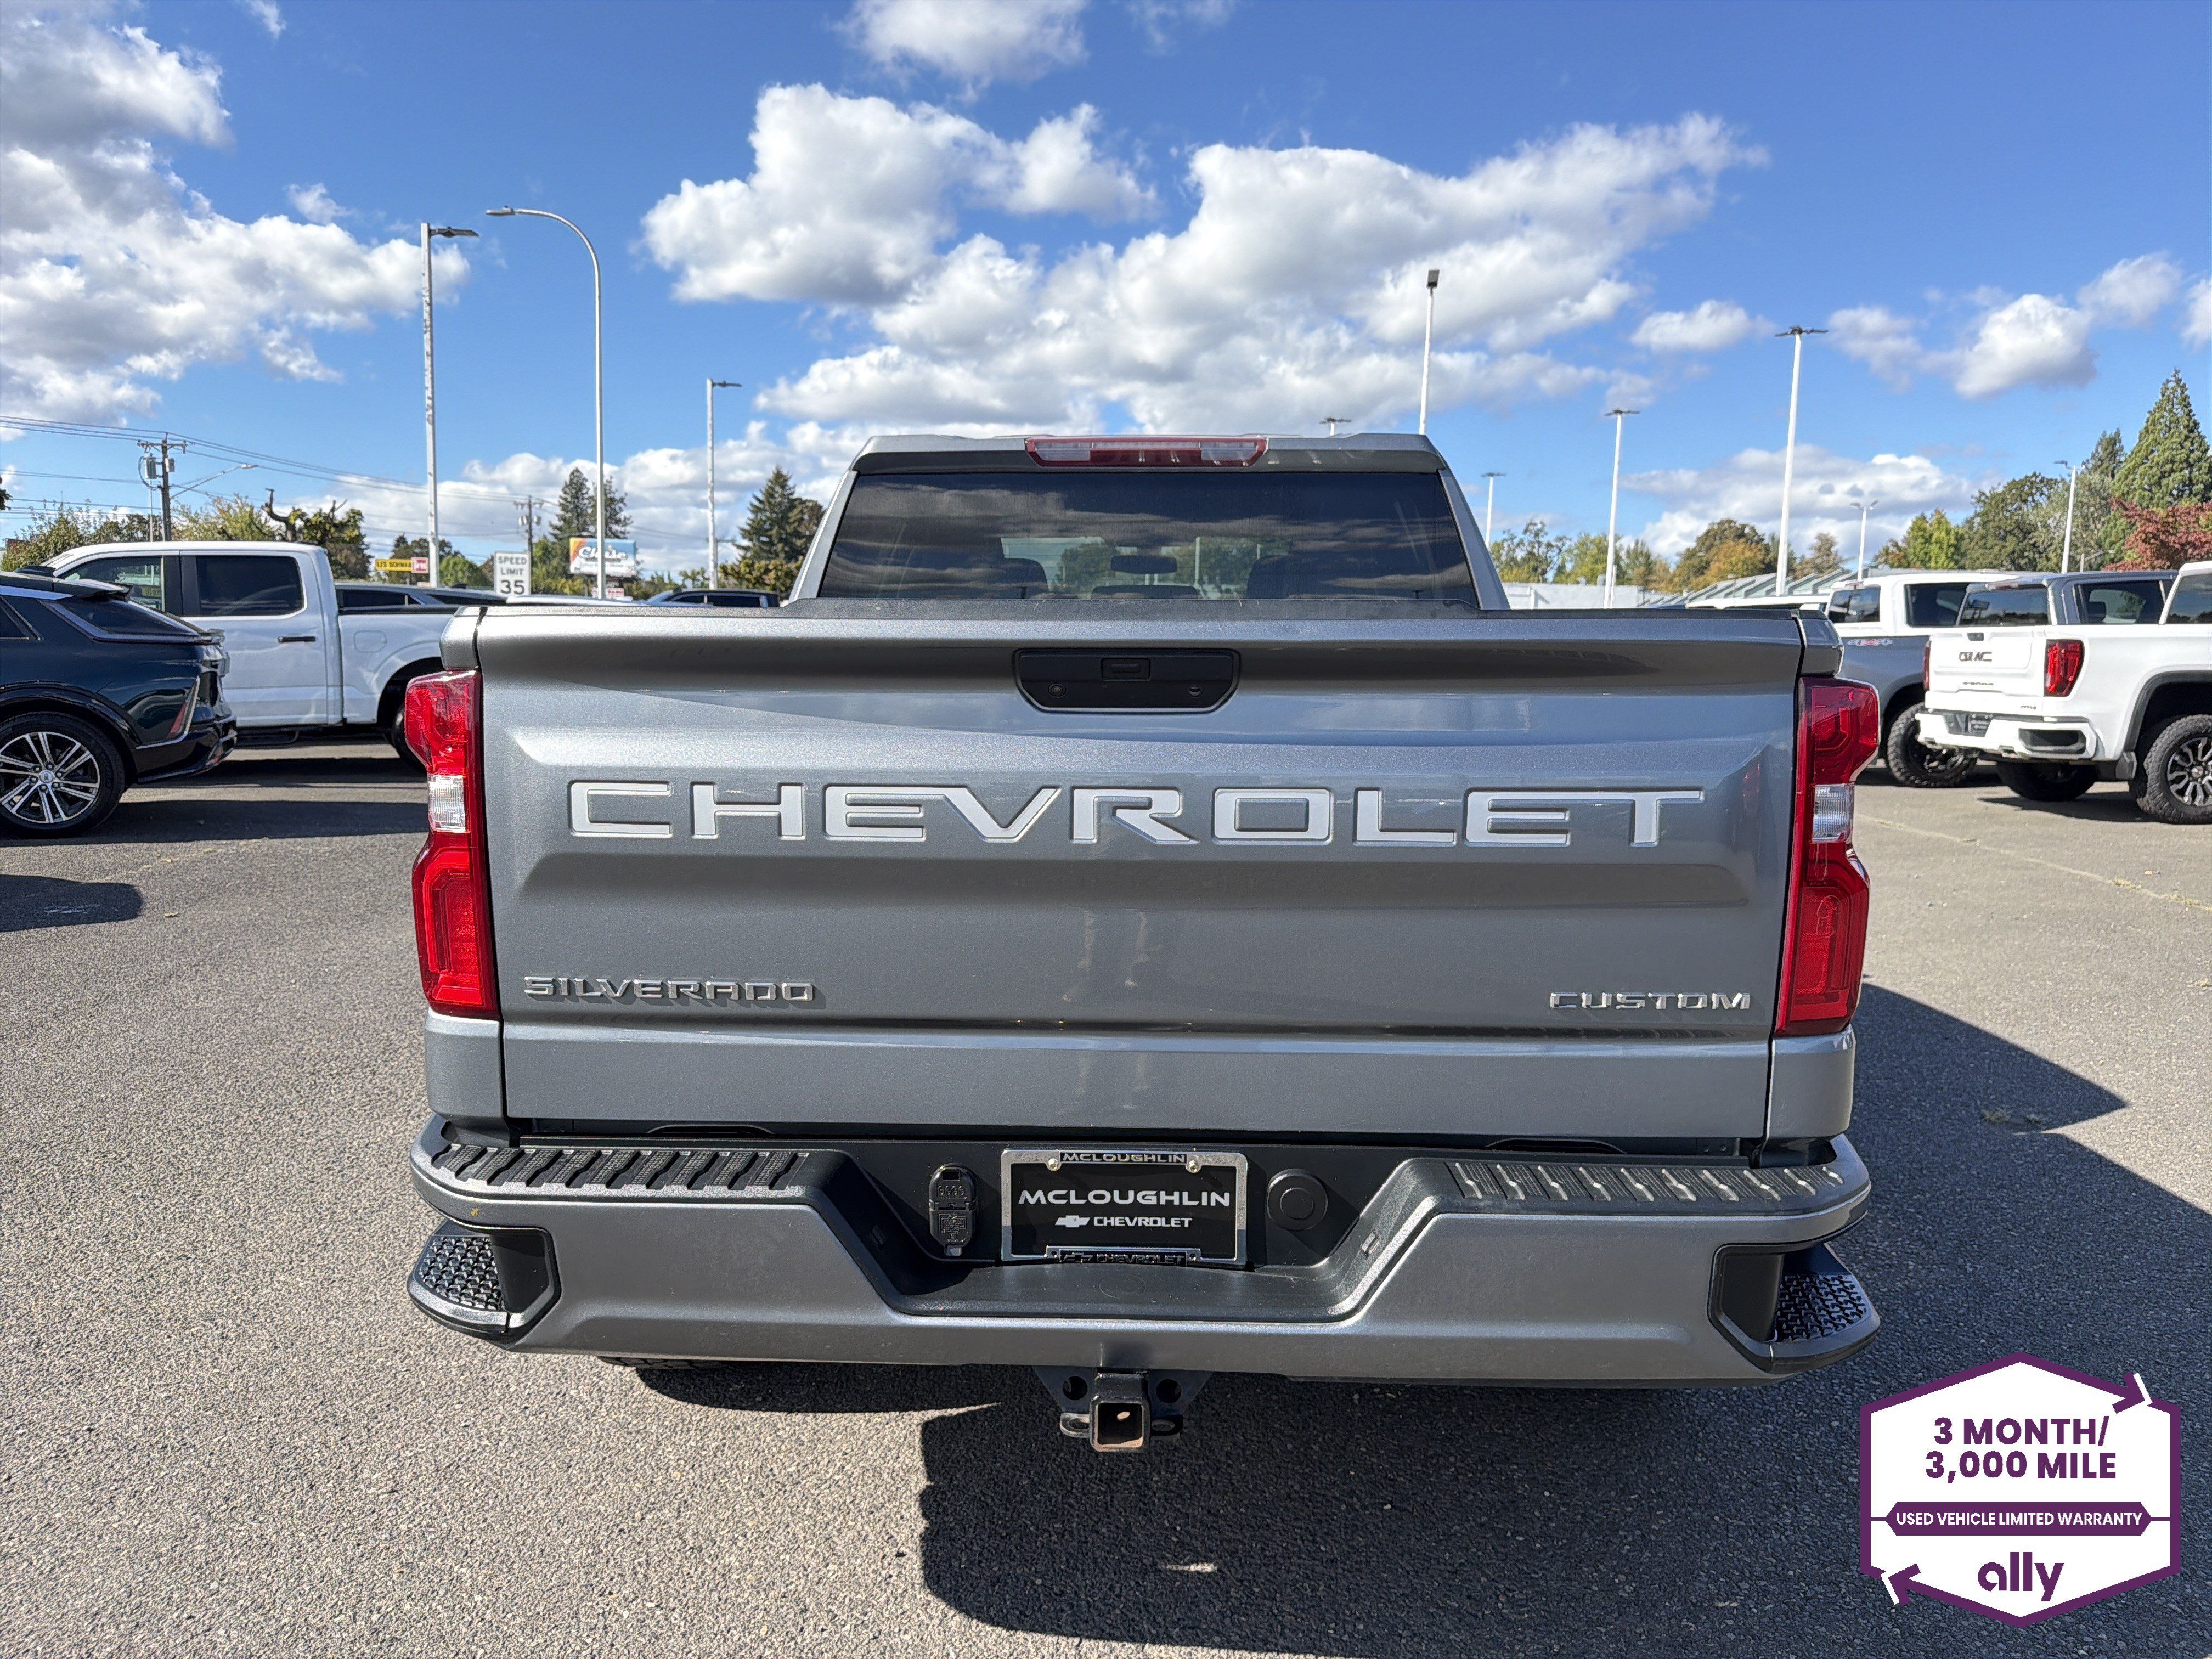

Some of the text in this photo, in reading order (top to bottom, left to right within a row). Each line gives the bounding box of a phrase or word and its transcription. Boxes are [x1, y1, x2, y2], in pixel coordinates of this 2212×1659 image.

[498, 556, 527, 565] SPEED
[500, 567, 523, 575] LIMIT
[500, 579, 525, 594] 35
[1959, 651, 1993, 662] GMC
[568, 780, 1706, 848] CHEVROLET
[523, 977, 814, 1001] SILVERADO
[1549, 992, 1751, 1009] CUSTOM
[1063, 1153, 1185, 1163] MCLOUGHLIN
[1018, 1189, 1230, 1207] MCLOUGHLIN
[1093, 1216, 1193, 1228] CHEVROLET
[1097, 1254, 1184, 1265] CHEVROLET
